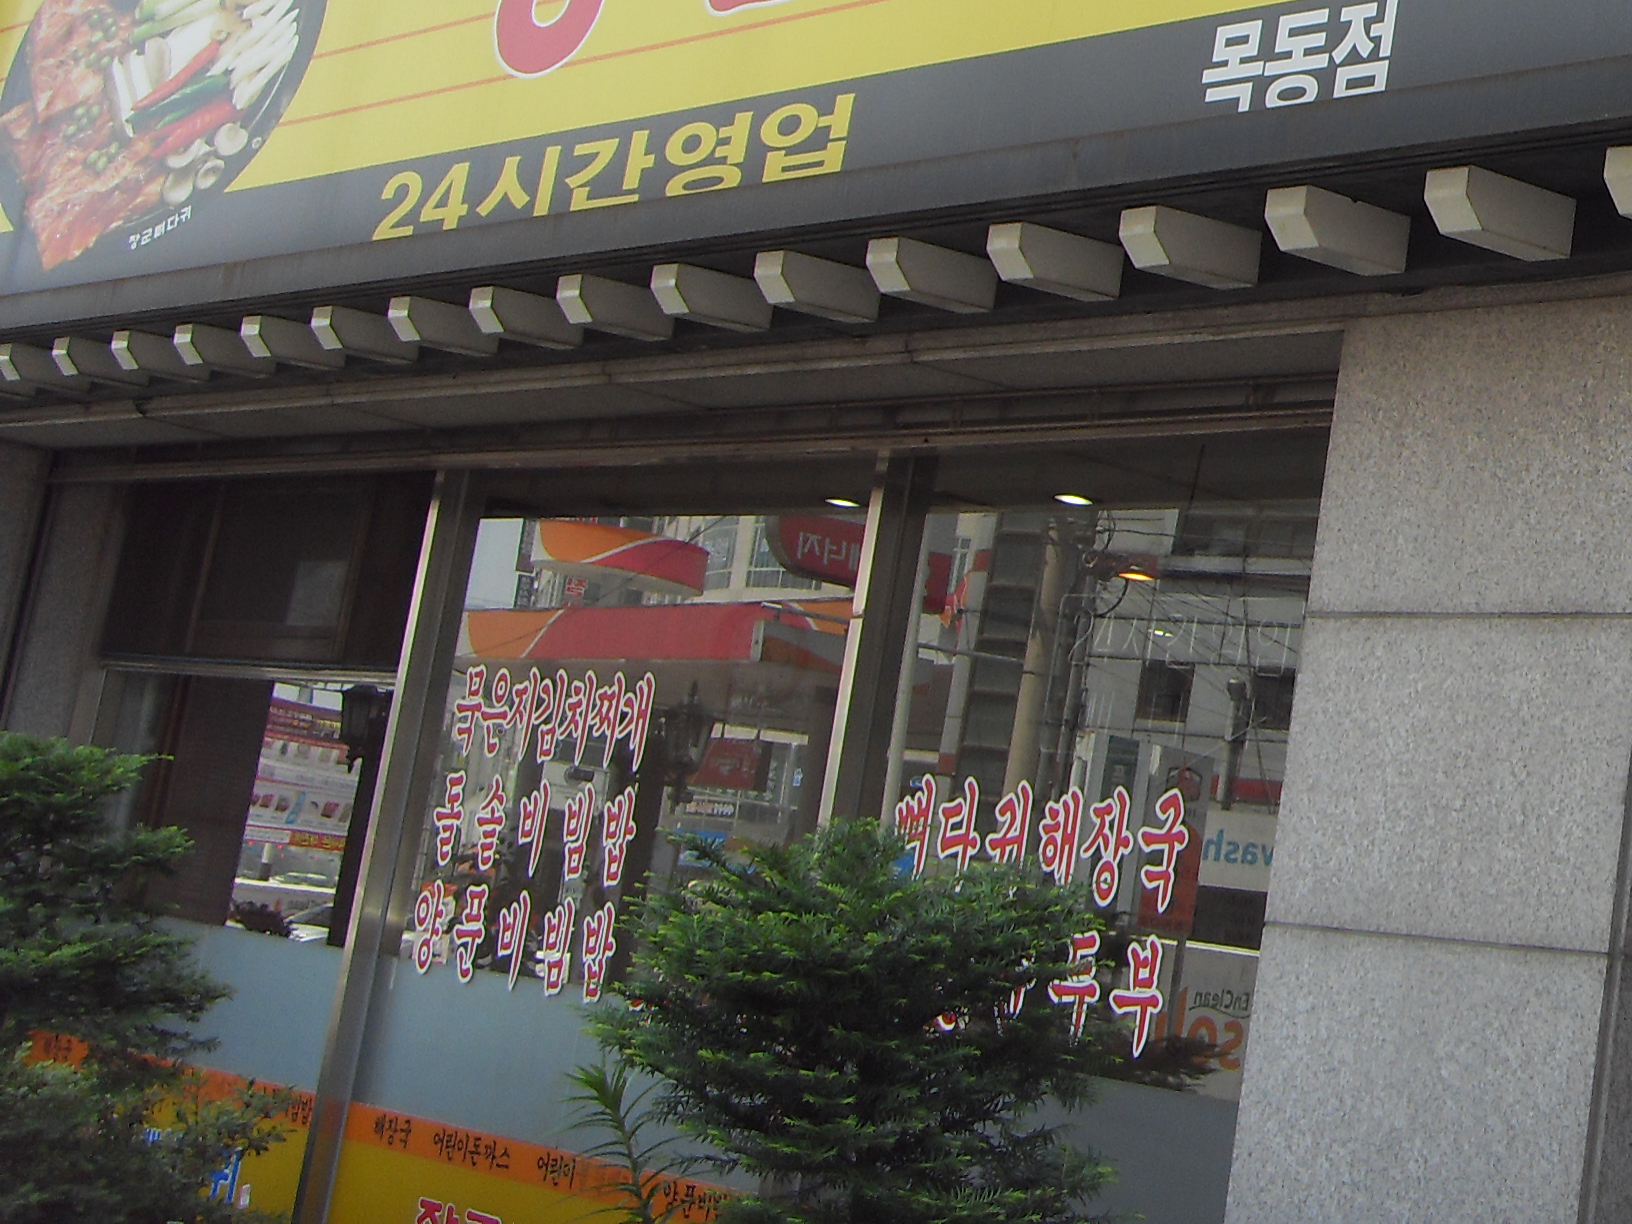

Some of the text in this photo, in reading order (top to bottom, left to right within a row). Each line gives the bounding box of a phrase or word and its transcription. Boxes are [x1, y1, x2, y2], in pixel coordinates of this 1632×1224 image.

[370, 92, 857, 242] 24시간영업
[455, 663, 656, 773] 묵은지김치찌개
[433, 769, 637, 889] 돌솥비빔밥
[414, 878, 617, 1004] 양푼비빔밥
